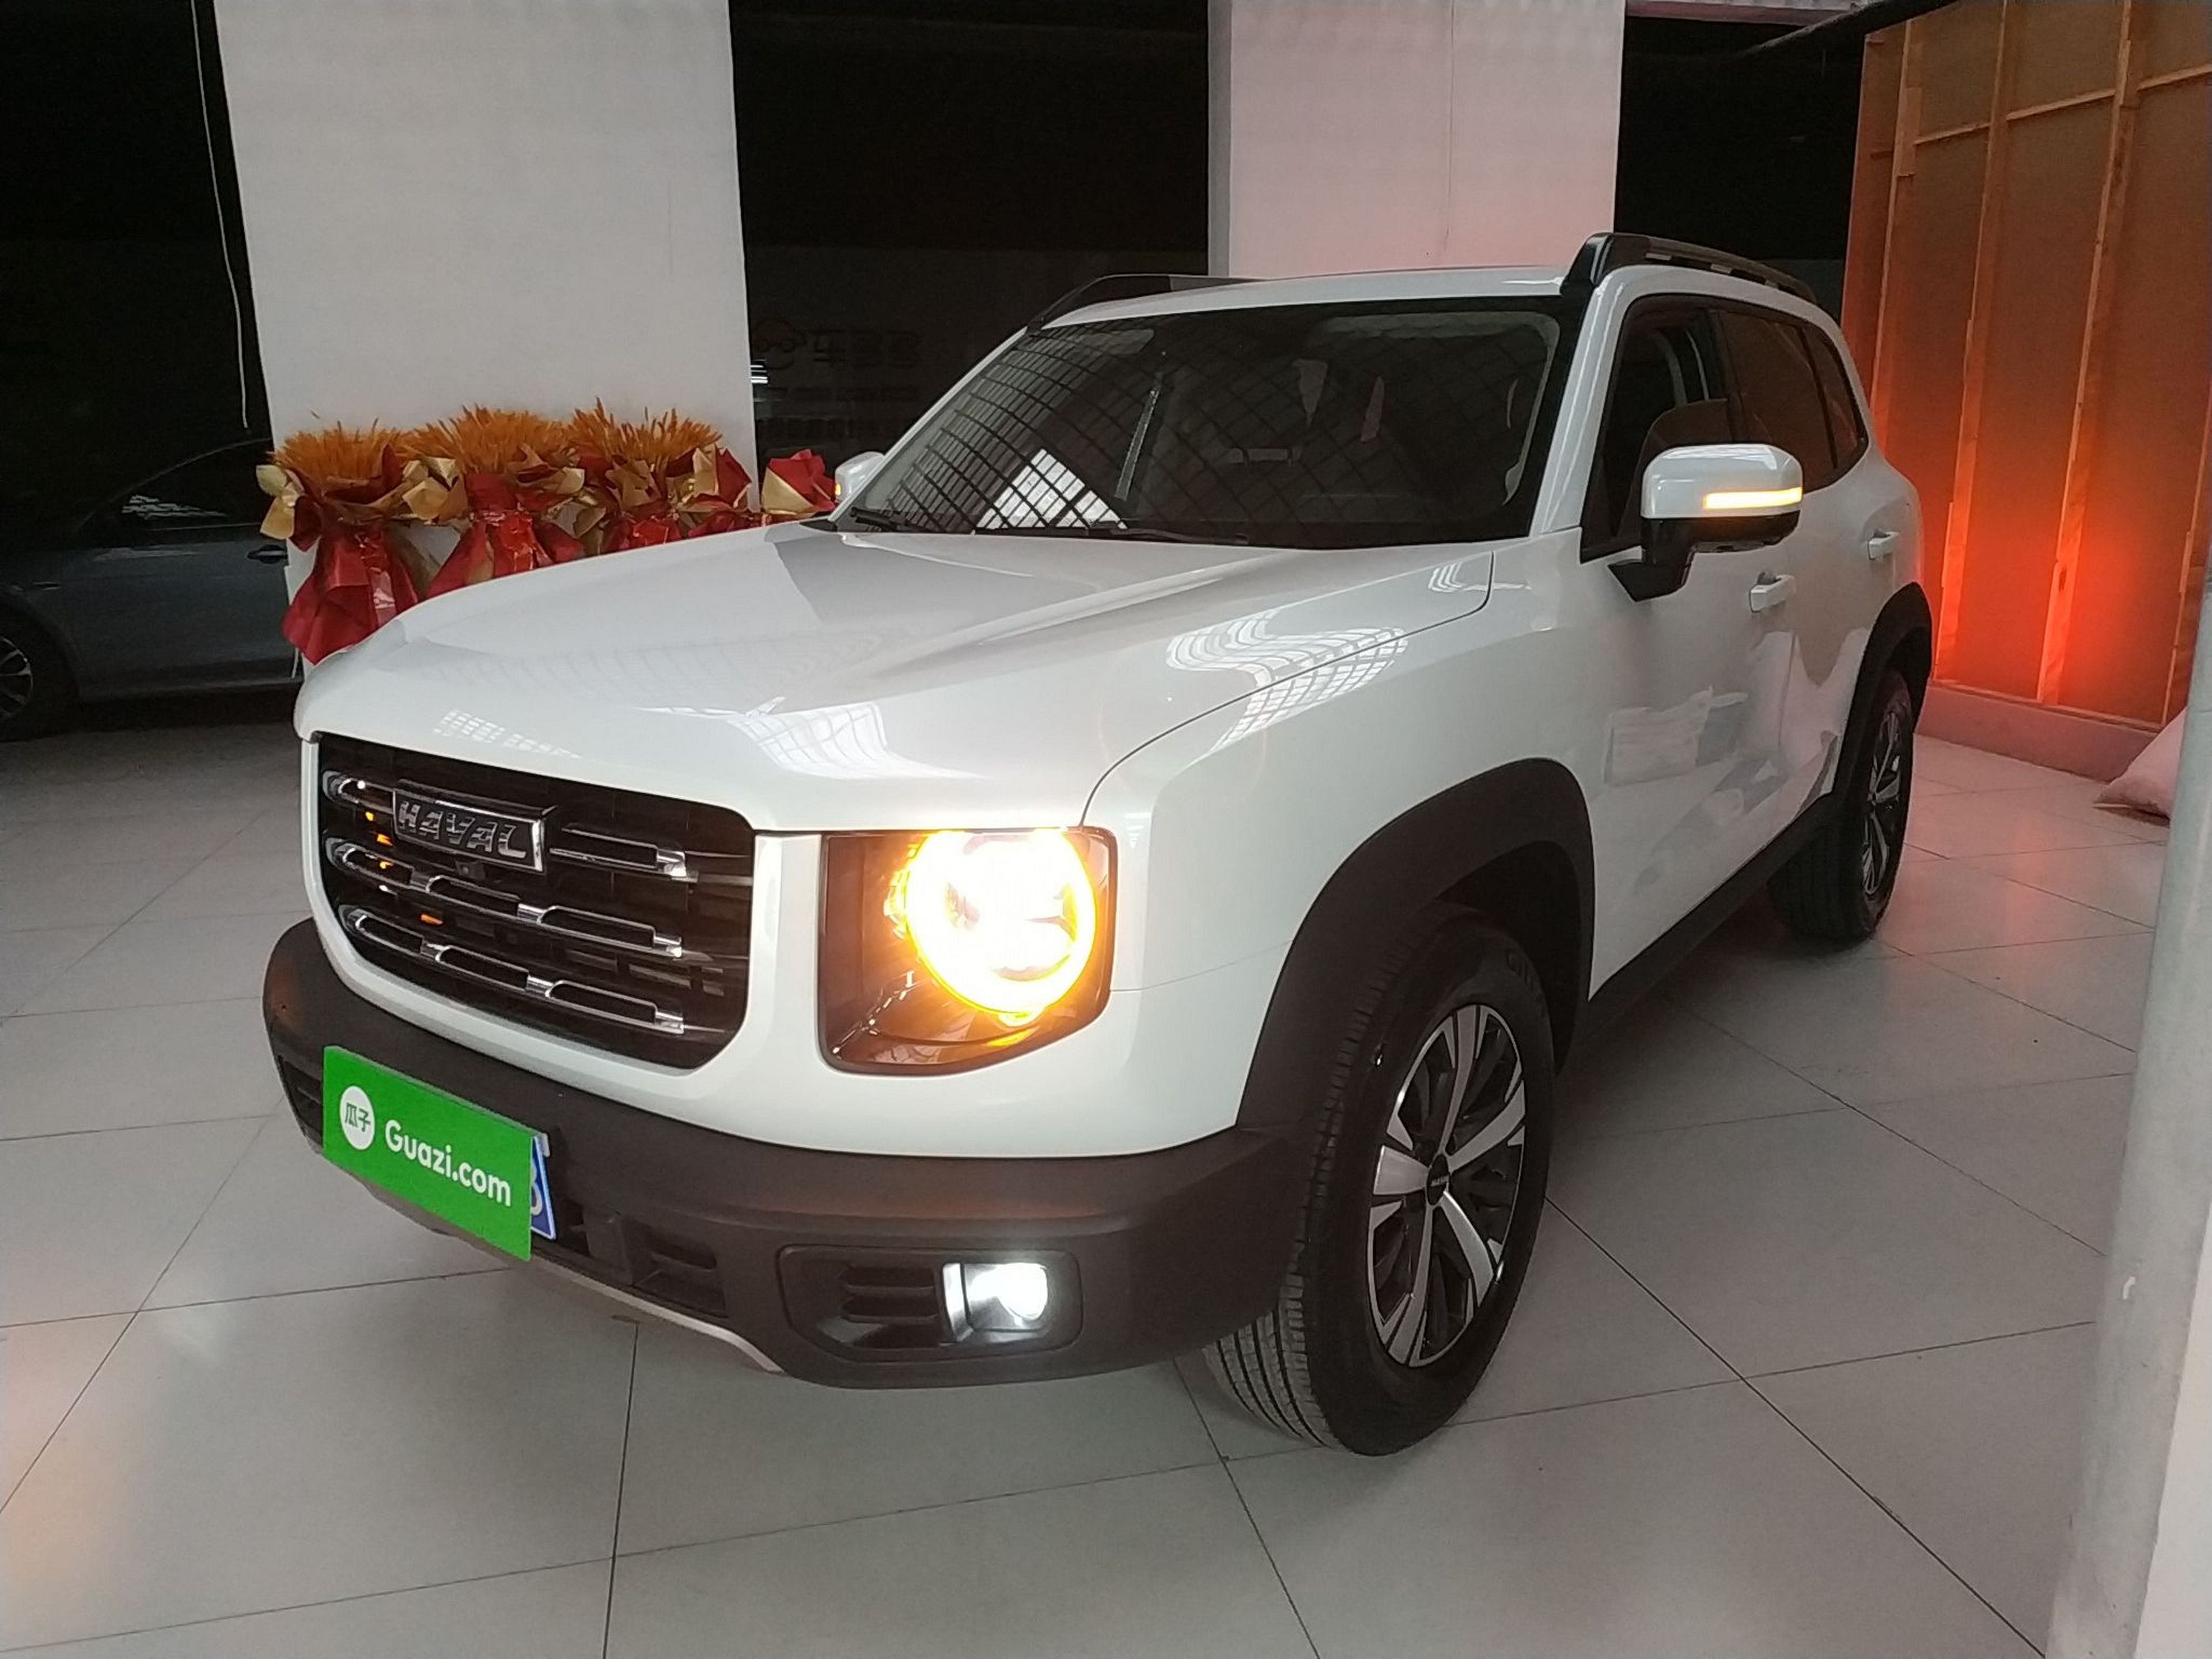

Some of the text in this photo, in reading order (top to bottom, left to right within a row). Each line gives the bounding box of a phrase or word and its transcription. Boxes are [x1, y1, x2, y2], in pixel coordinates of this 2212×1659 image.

[399, 801, 527, 858] HAVAL
[344, 1102, 371, 1132] 瓜子
[385, 1119, 512, 1207] Guazi.com
